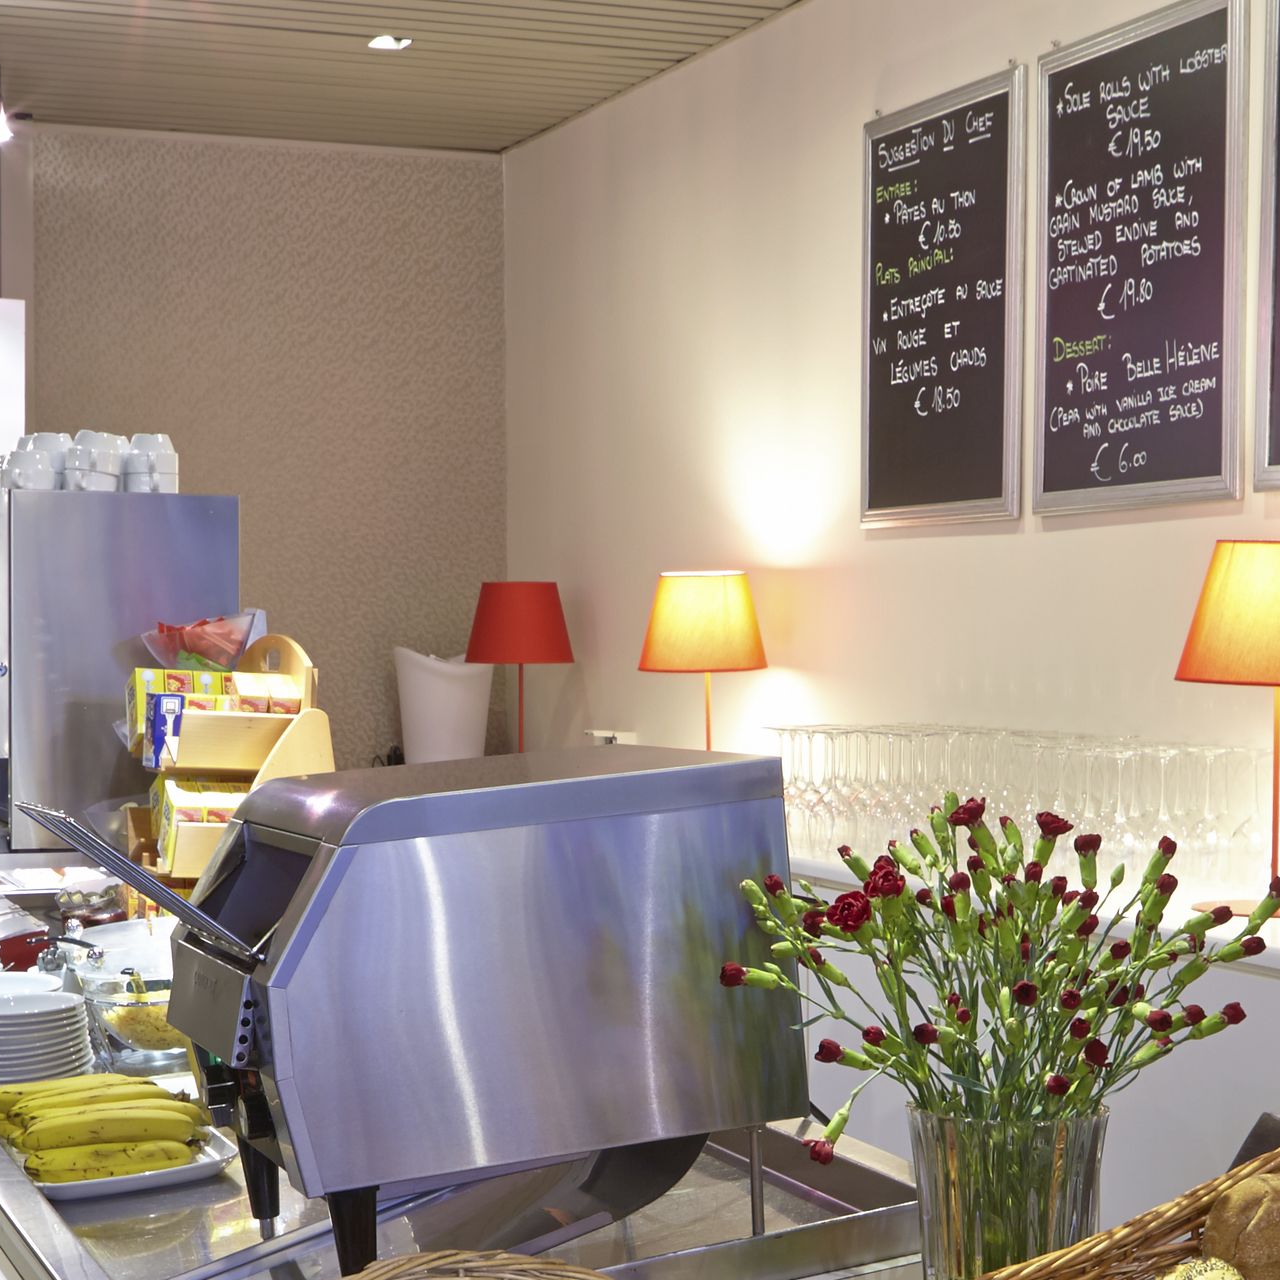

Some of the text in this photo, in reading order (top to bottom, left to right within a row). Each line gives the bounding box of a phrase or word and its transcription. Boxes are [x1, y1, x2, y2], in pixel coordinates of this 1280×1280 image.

[1106, 96, 1151, 129] SAUCE
[1106, 178, 1122, 197] OF
[1131, 163, 1163, 189] LAMB
[931, 198, 945, 215] AU
[950, 189, 976, 210] THON
[1089, 194, 1139, 225] MUSTARD
[1057, 230, 1102, 262] STEWED
[1175, 211, 1199, 230] AND
[1141, 235, 1201, 267] POTATOES
[956, 283, 969, 300] AU
[976, 278, 1003, 300] SAUCE
[897, 328, 927, 350] ROUGE
[944, 321, 960, 338] ET
[1083, 422, 1101, 439] AND
